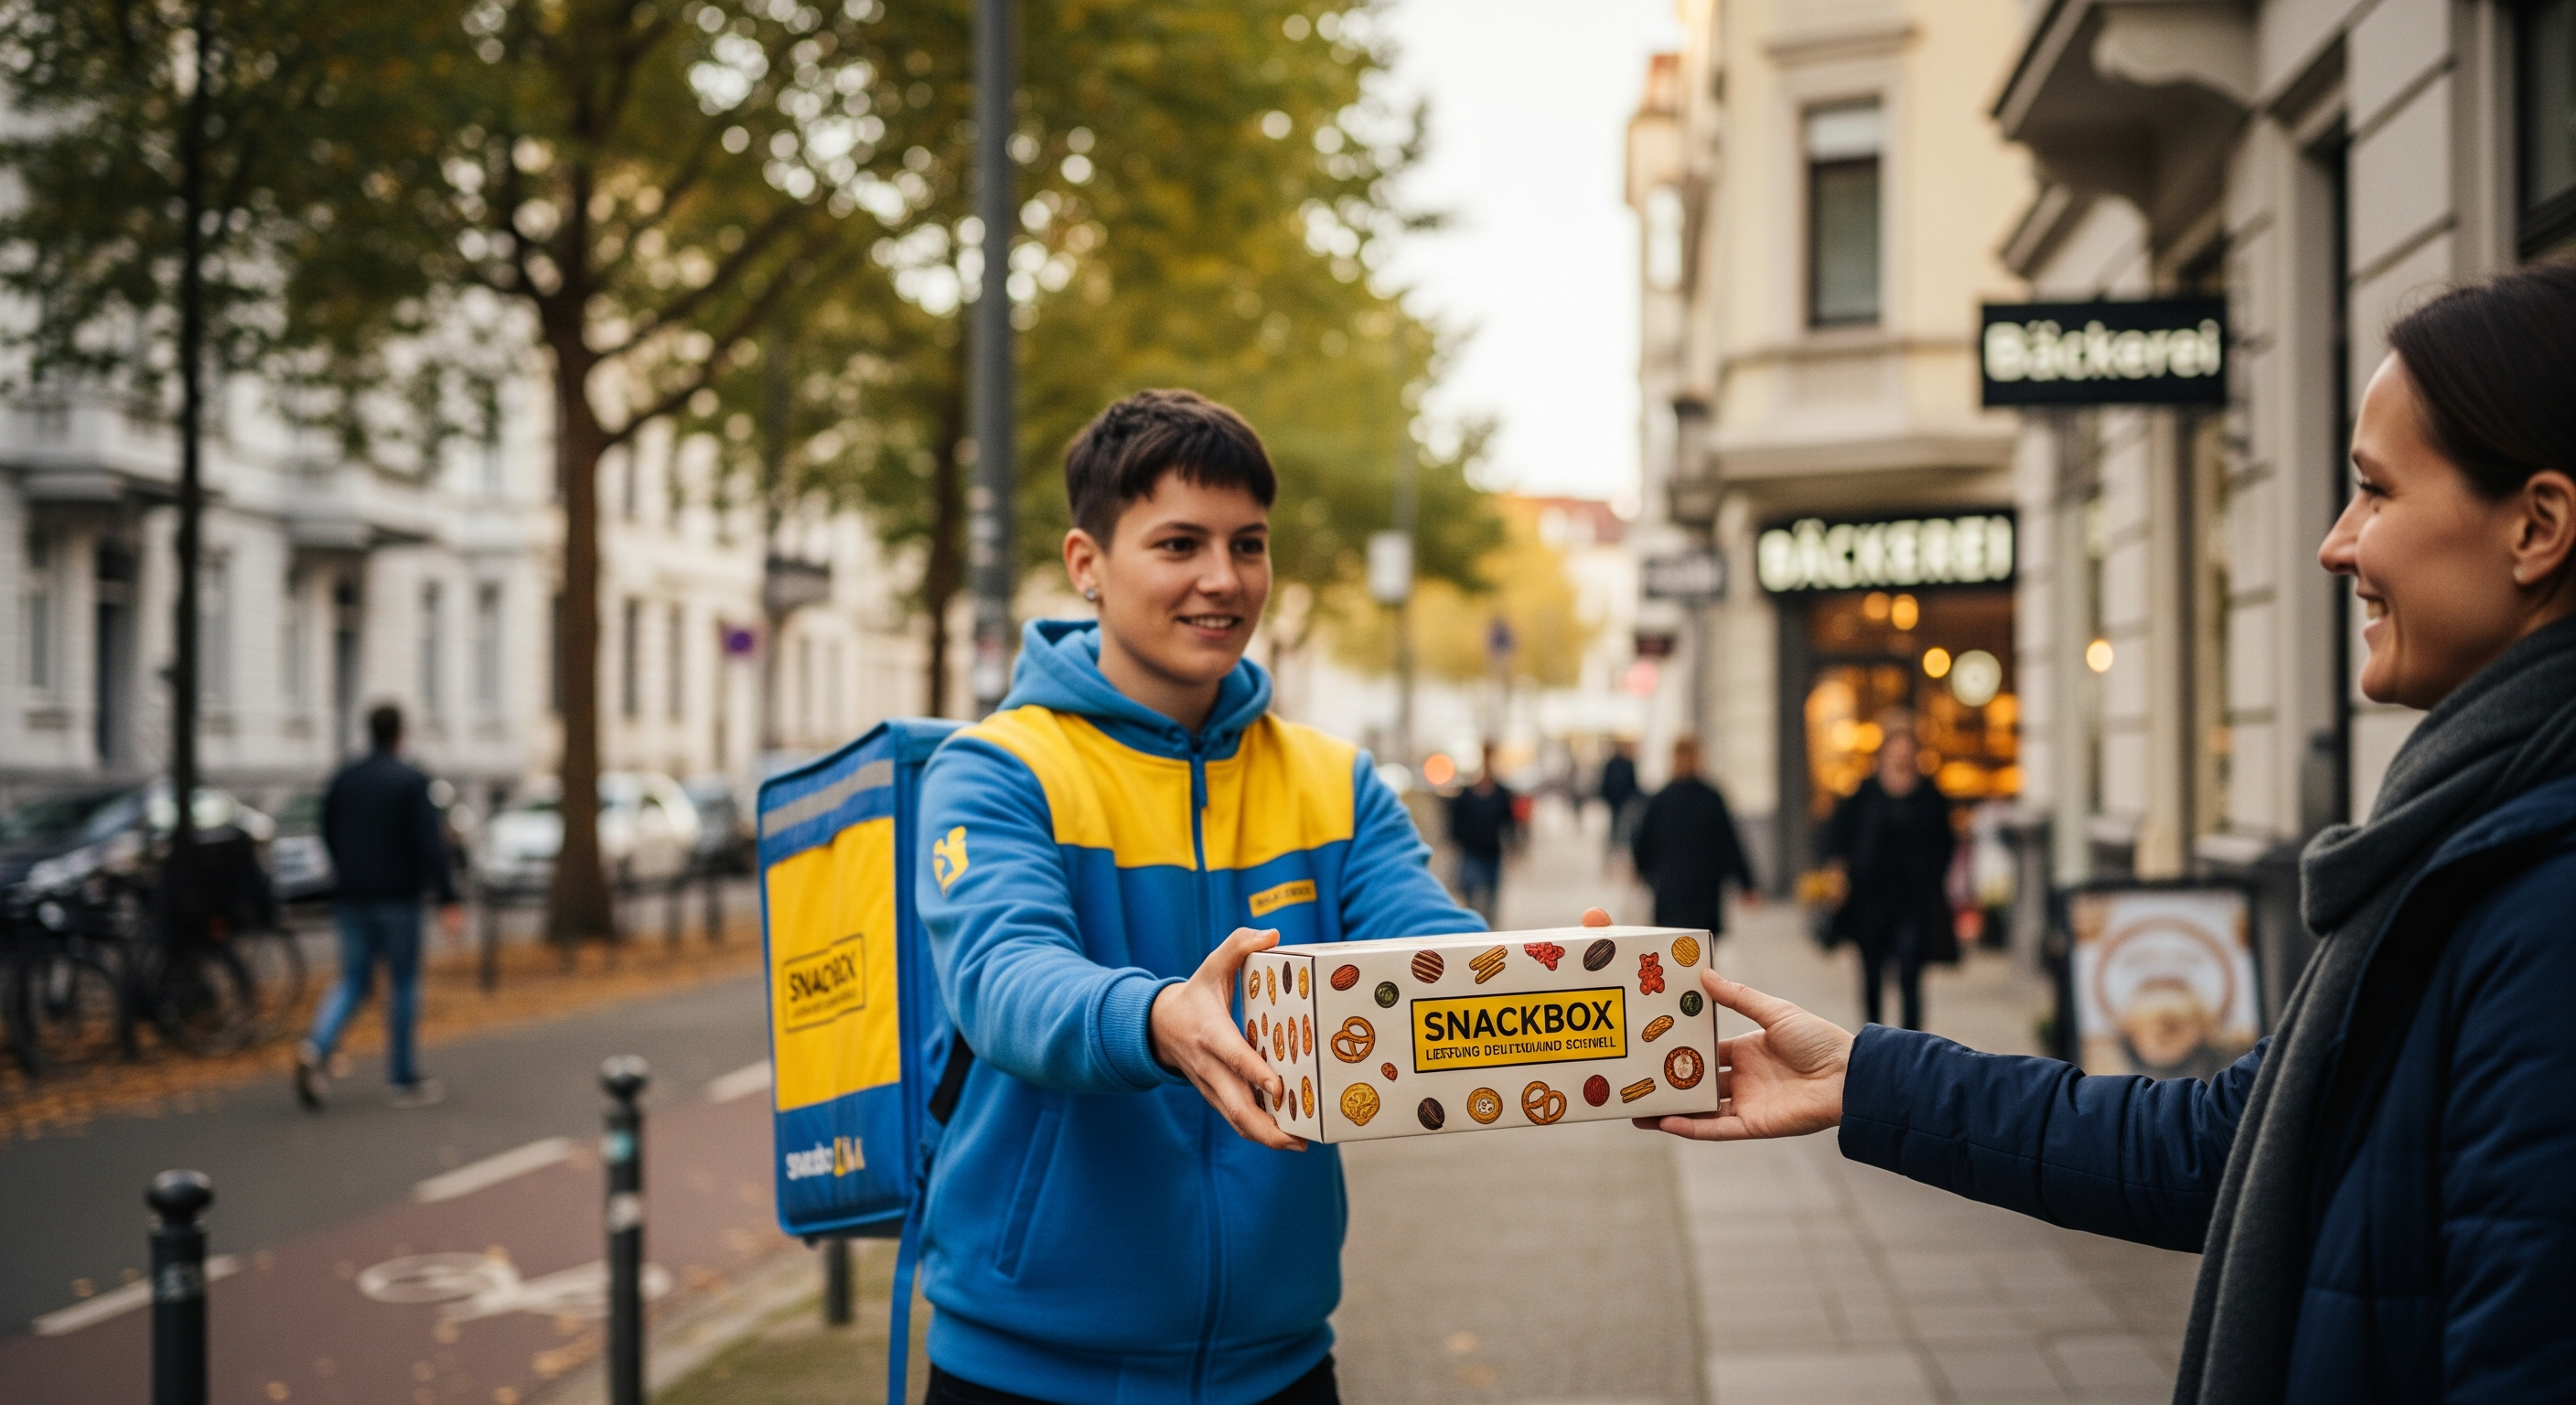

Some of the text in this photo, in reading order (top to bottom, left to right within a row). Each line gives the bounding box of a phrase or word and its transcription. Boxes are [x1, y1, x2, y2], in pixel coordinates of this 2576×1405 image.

[1984, 319, 2222, 382] Bäckerei
[1758, 515, 2012, 592] BÄCKEREI
[1424, 1000, 1615, 1042] SNACKBOX
